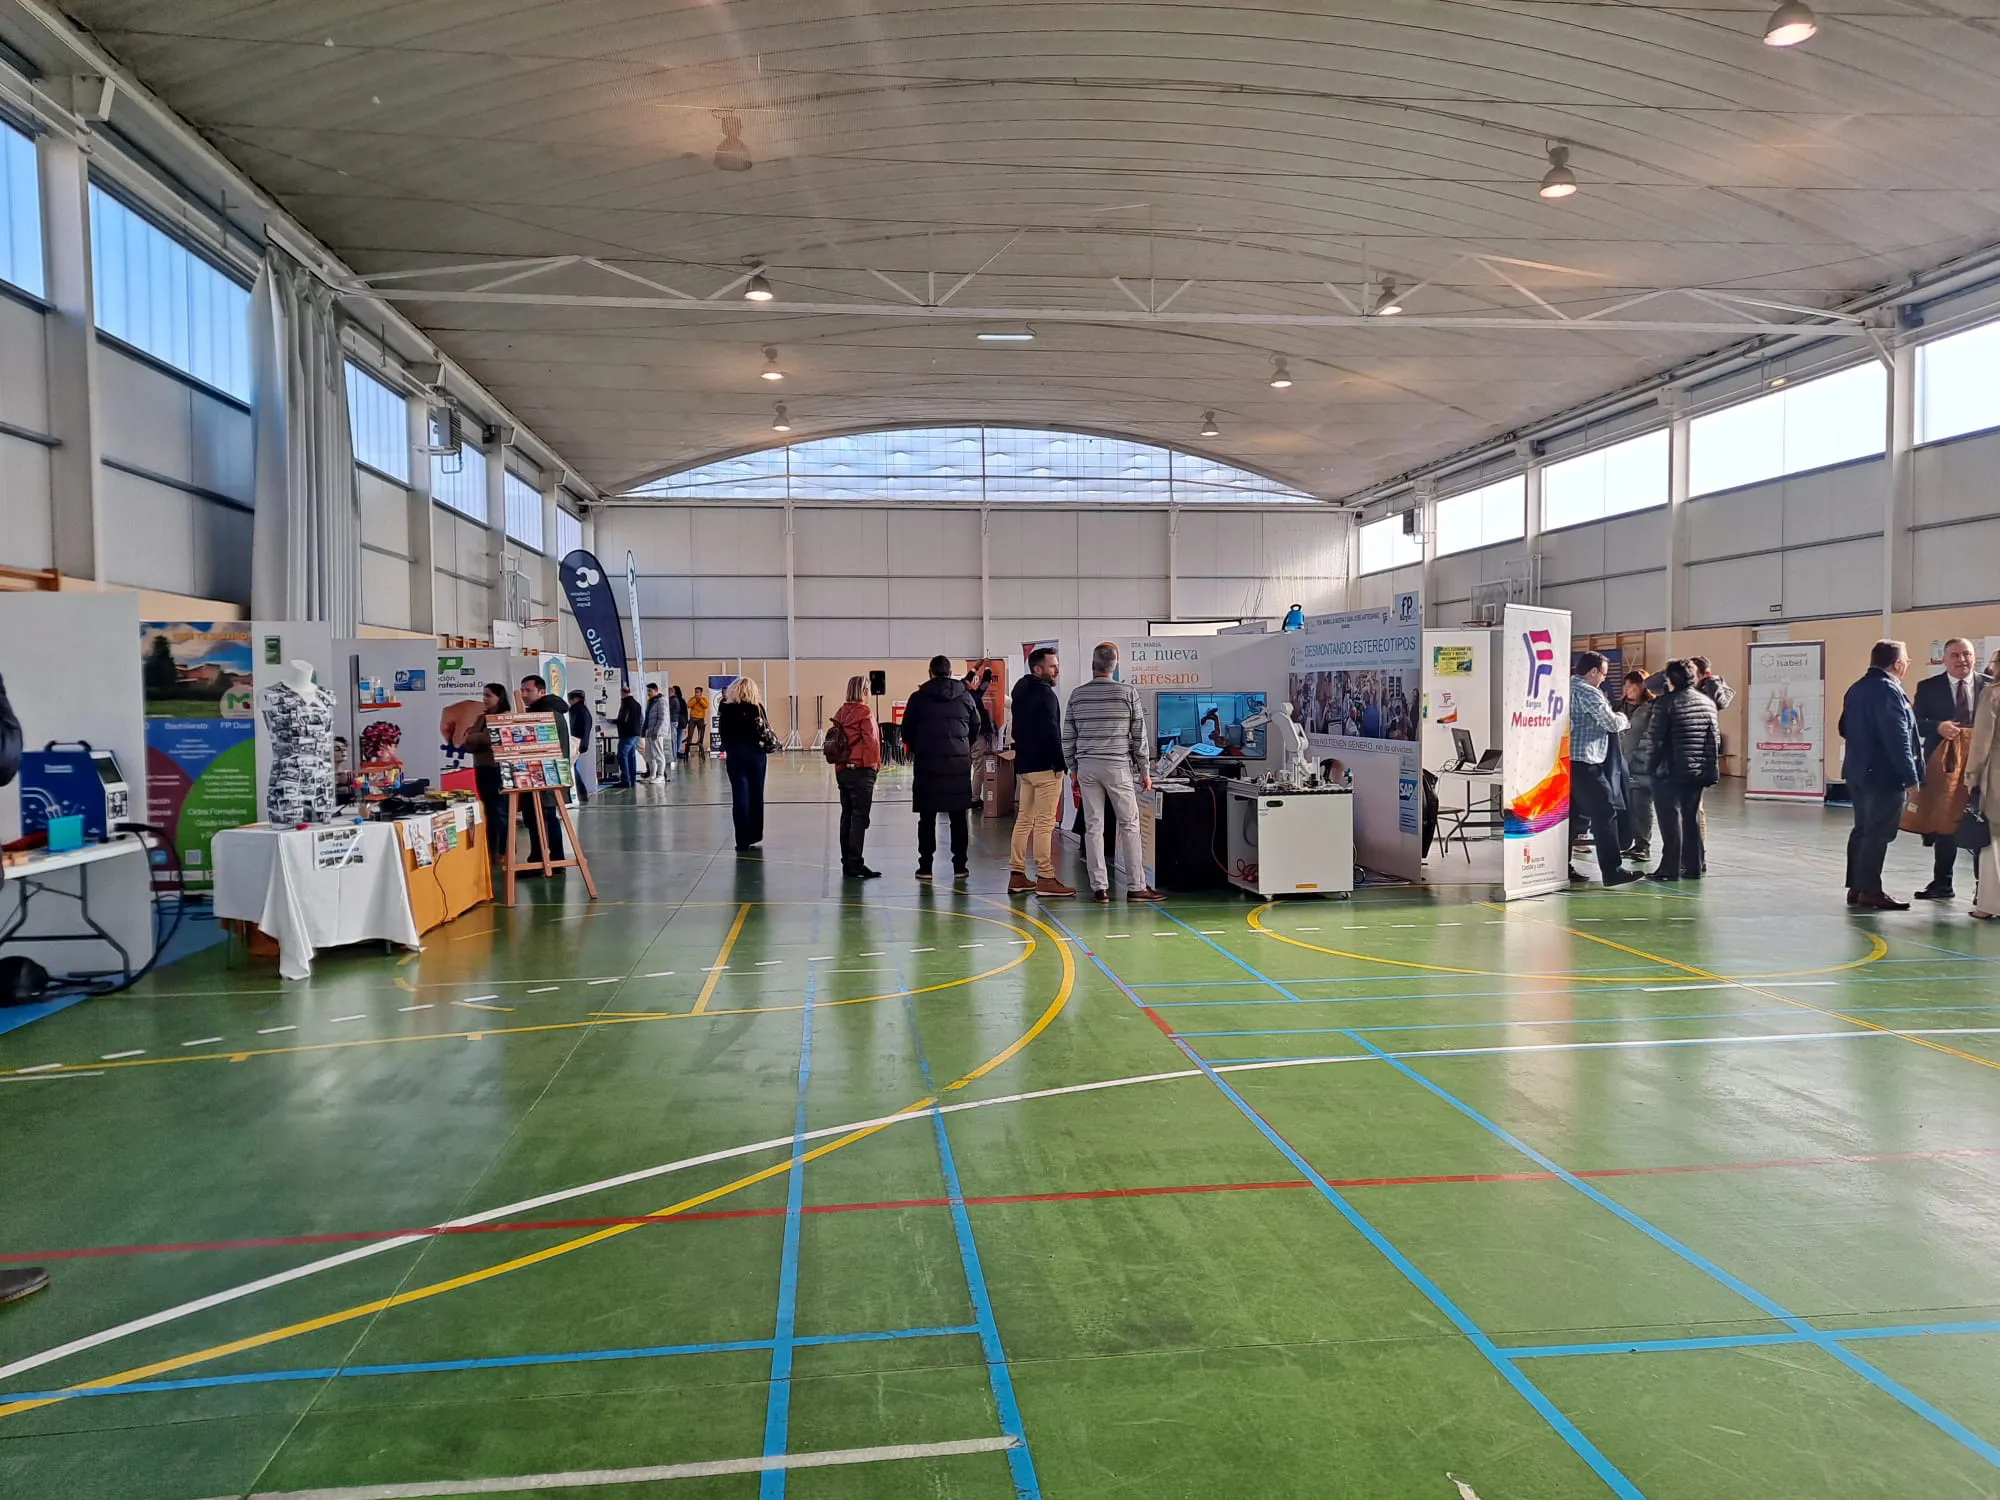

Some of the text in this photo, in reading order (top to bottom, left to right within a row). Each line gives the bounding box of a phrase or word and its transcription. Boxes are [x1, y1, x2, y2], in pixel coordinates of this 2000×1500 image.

[1304, 636, 1416, 658] DESMONTANDO ESTEREOTIPOS
[1155, 648, 1199, 661] nueva
[1776, 659, 1802, 667] Isabel
[438, 681, 476, 689] rofesional
[1511, 711, 1551, 729] Muestra
[1400, 783, 1413, 798] SAP
